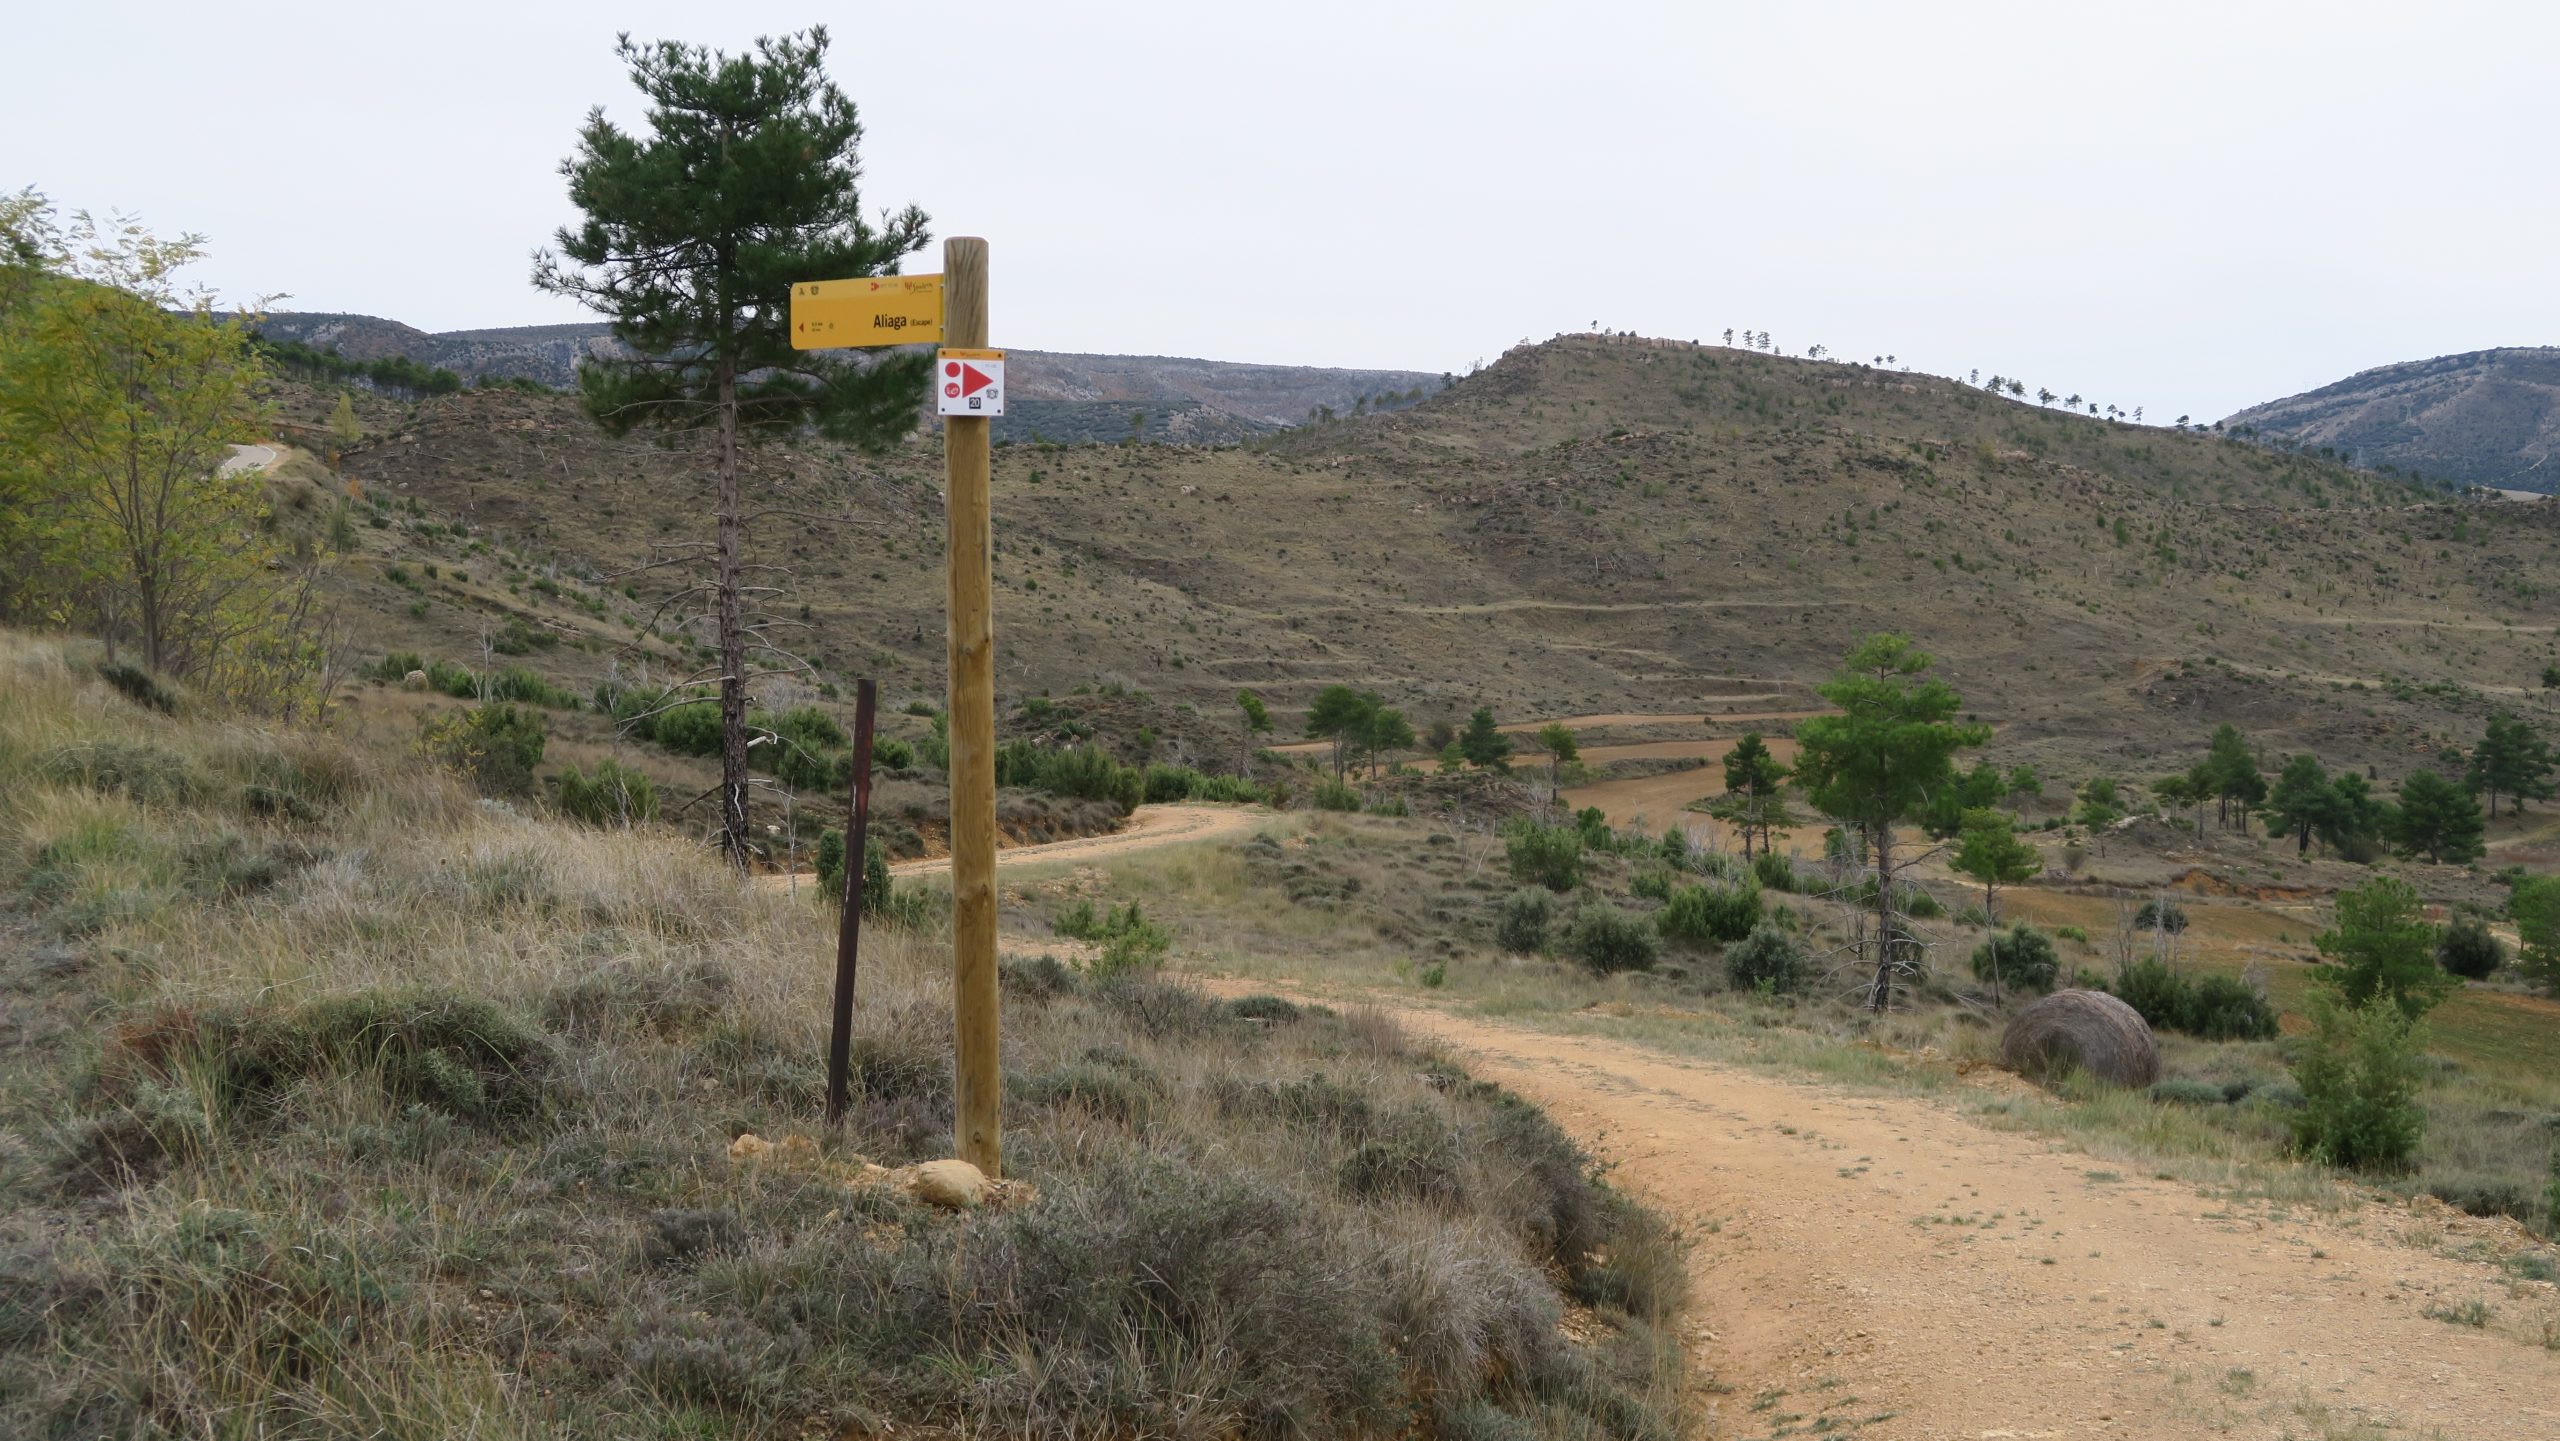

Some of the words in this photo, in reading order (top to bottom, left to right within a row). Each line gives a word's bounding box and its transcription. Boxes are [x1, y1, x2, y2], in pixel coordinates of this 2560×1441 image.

[873, 313, 907, 330] Aliaga
[910, 318, 933, 326] (Escape)
[970, 400, 980, 408] 20
